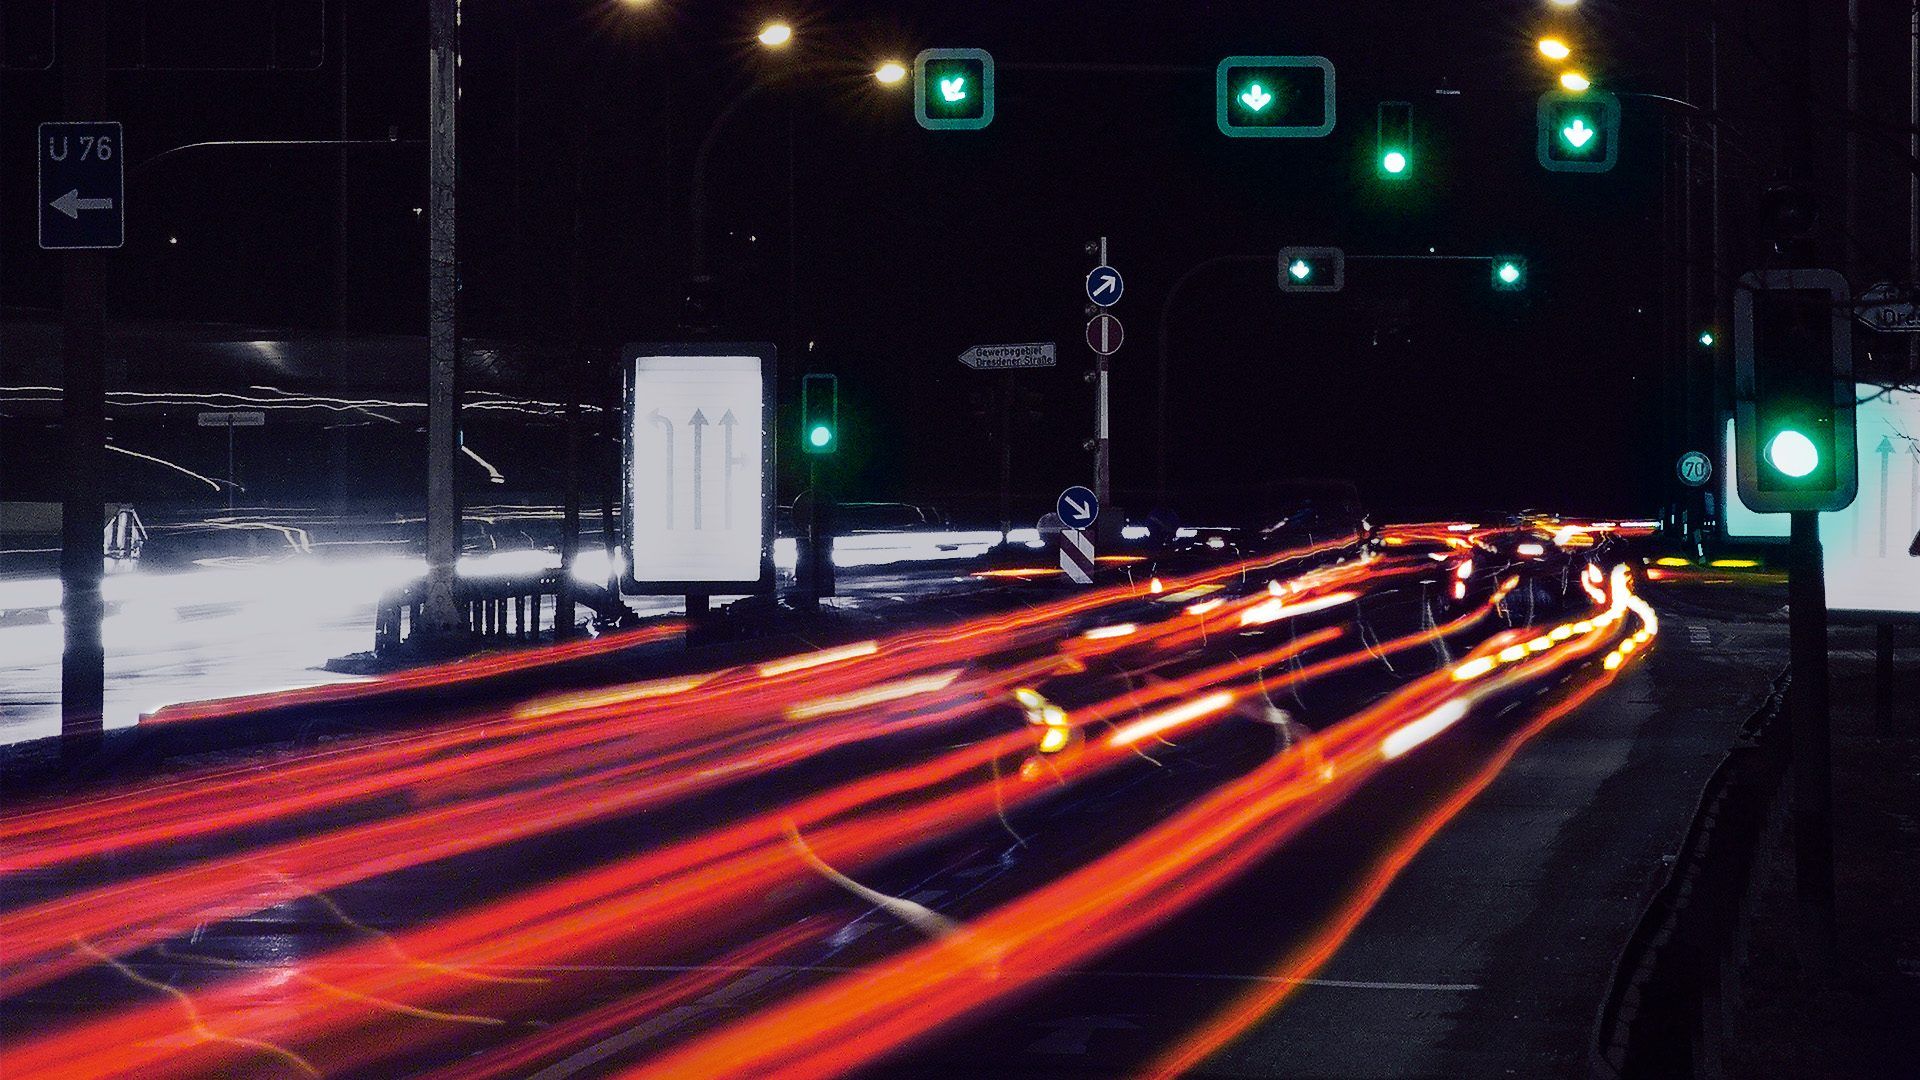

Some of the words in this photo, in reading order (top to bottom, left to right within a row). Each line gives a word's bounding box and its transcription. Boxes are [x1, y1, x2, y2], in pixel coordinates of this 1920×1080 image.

[50, 136, 68, 160] U
[80, 136, 111, 160] 76
[976, 347, 1042, 358] Gewerbegebiet
[976, 358, 1020, 367] Dresdener
[1025, 355, 1053, 366] Straße
[1685, 461, 1704, 477] 70
